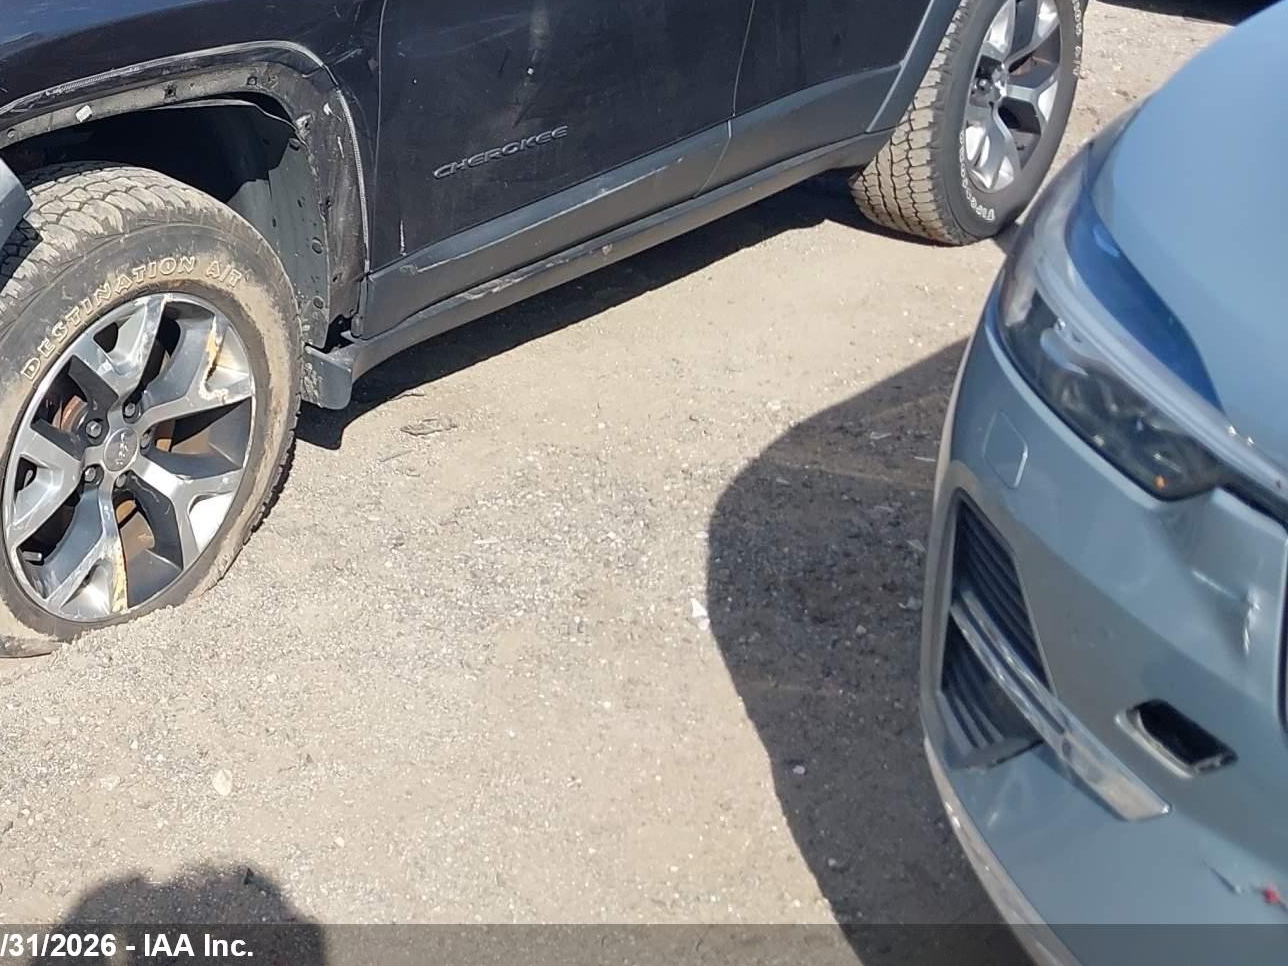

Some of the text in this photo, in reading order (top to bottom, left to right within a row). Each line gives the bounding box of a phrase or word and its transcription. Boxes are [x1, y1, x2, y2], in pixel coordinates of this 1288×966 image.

[431, 124, 569, 180] CHEROKEE
[19, 255, 243, 381] DESTINATION A/T
